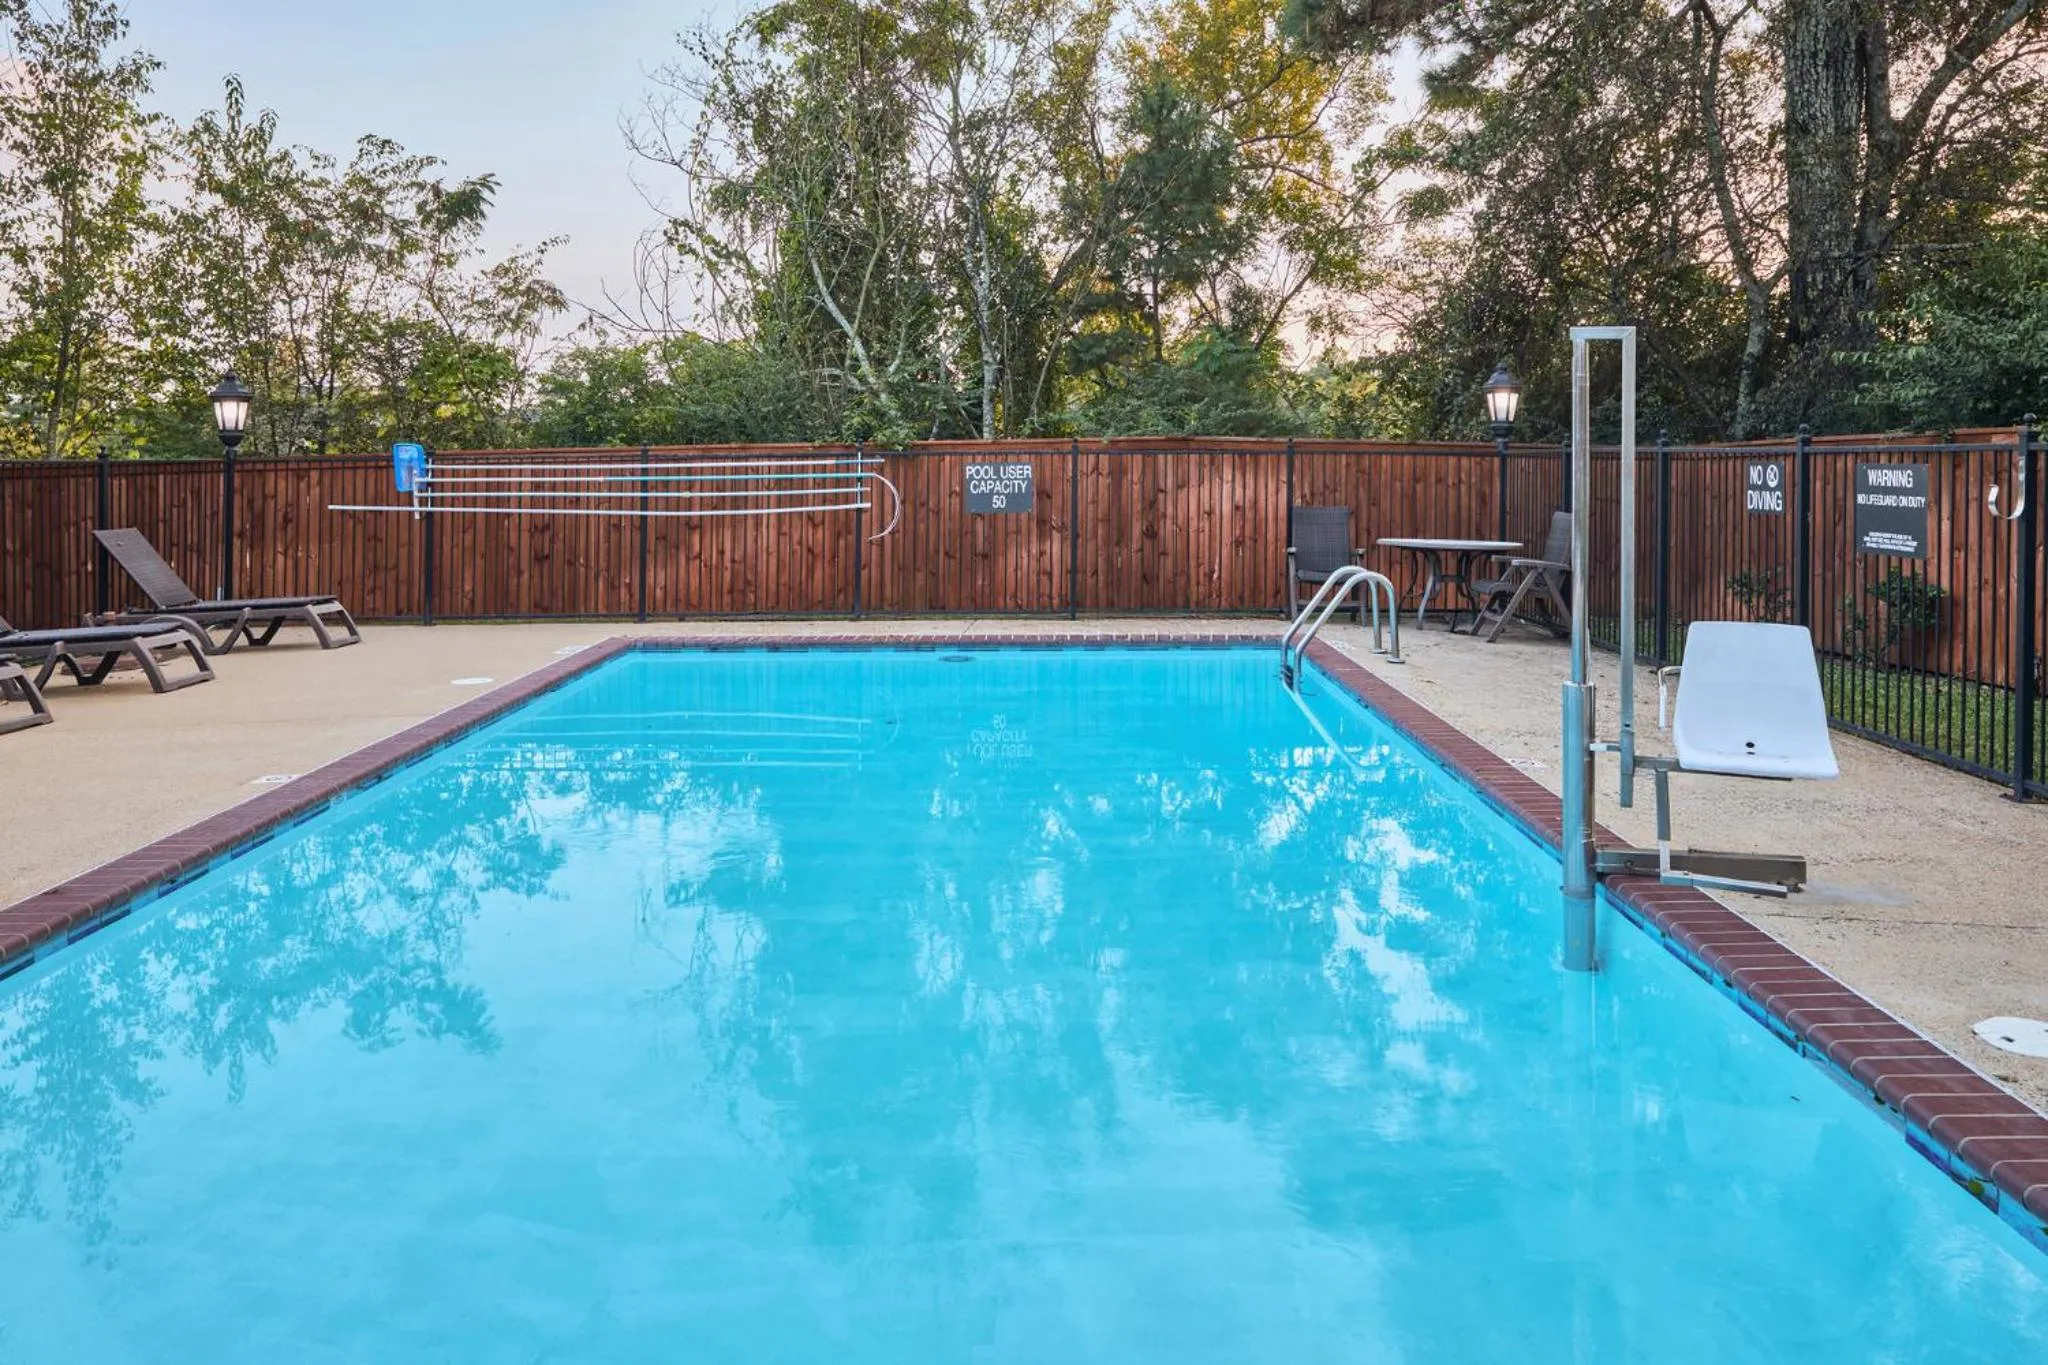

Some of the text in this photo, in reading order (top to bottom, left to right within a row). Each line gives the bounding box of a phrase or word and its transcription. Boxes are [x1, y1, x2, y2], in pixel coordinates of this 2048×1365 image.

[966, 464, 1032, 479] POOL USER
[1750, 464, 1763, 485] NO
[1867, 469, 1914, 488] WARNING
[970, 480, 1028, 494] CAPACITY
[992, 495, 1006, 508] 50
[1747, 490, 1782, 511] DIVING
[1857, 493, 1926, 508] NO LIFEGUARD ON DUTY
